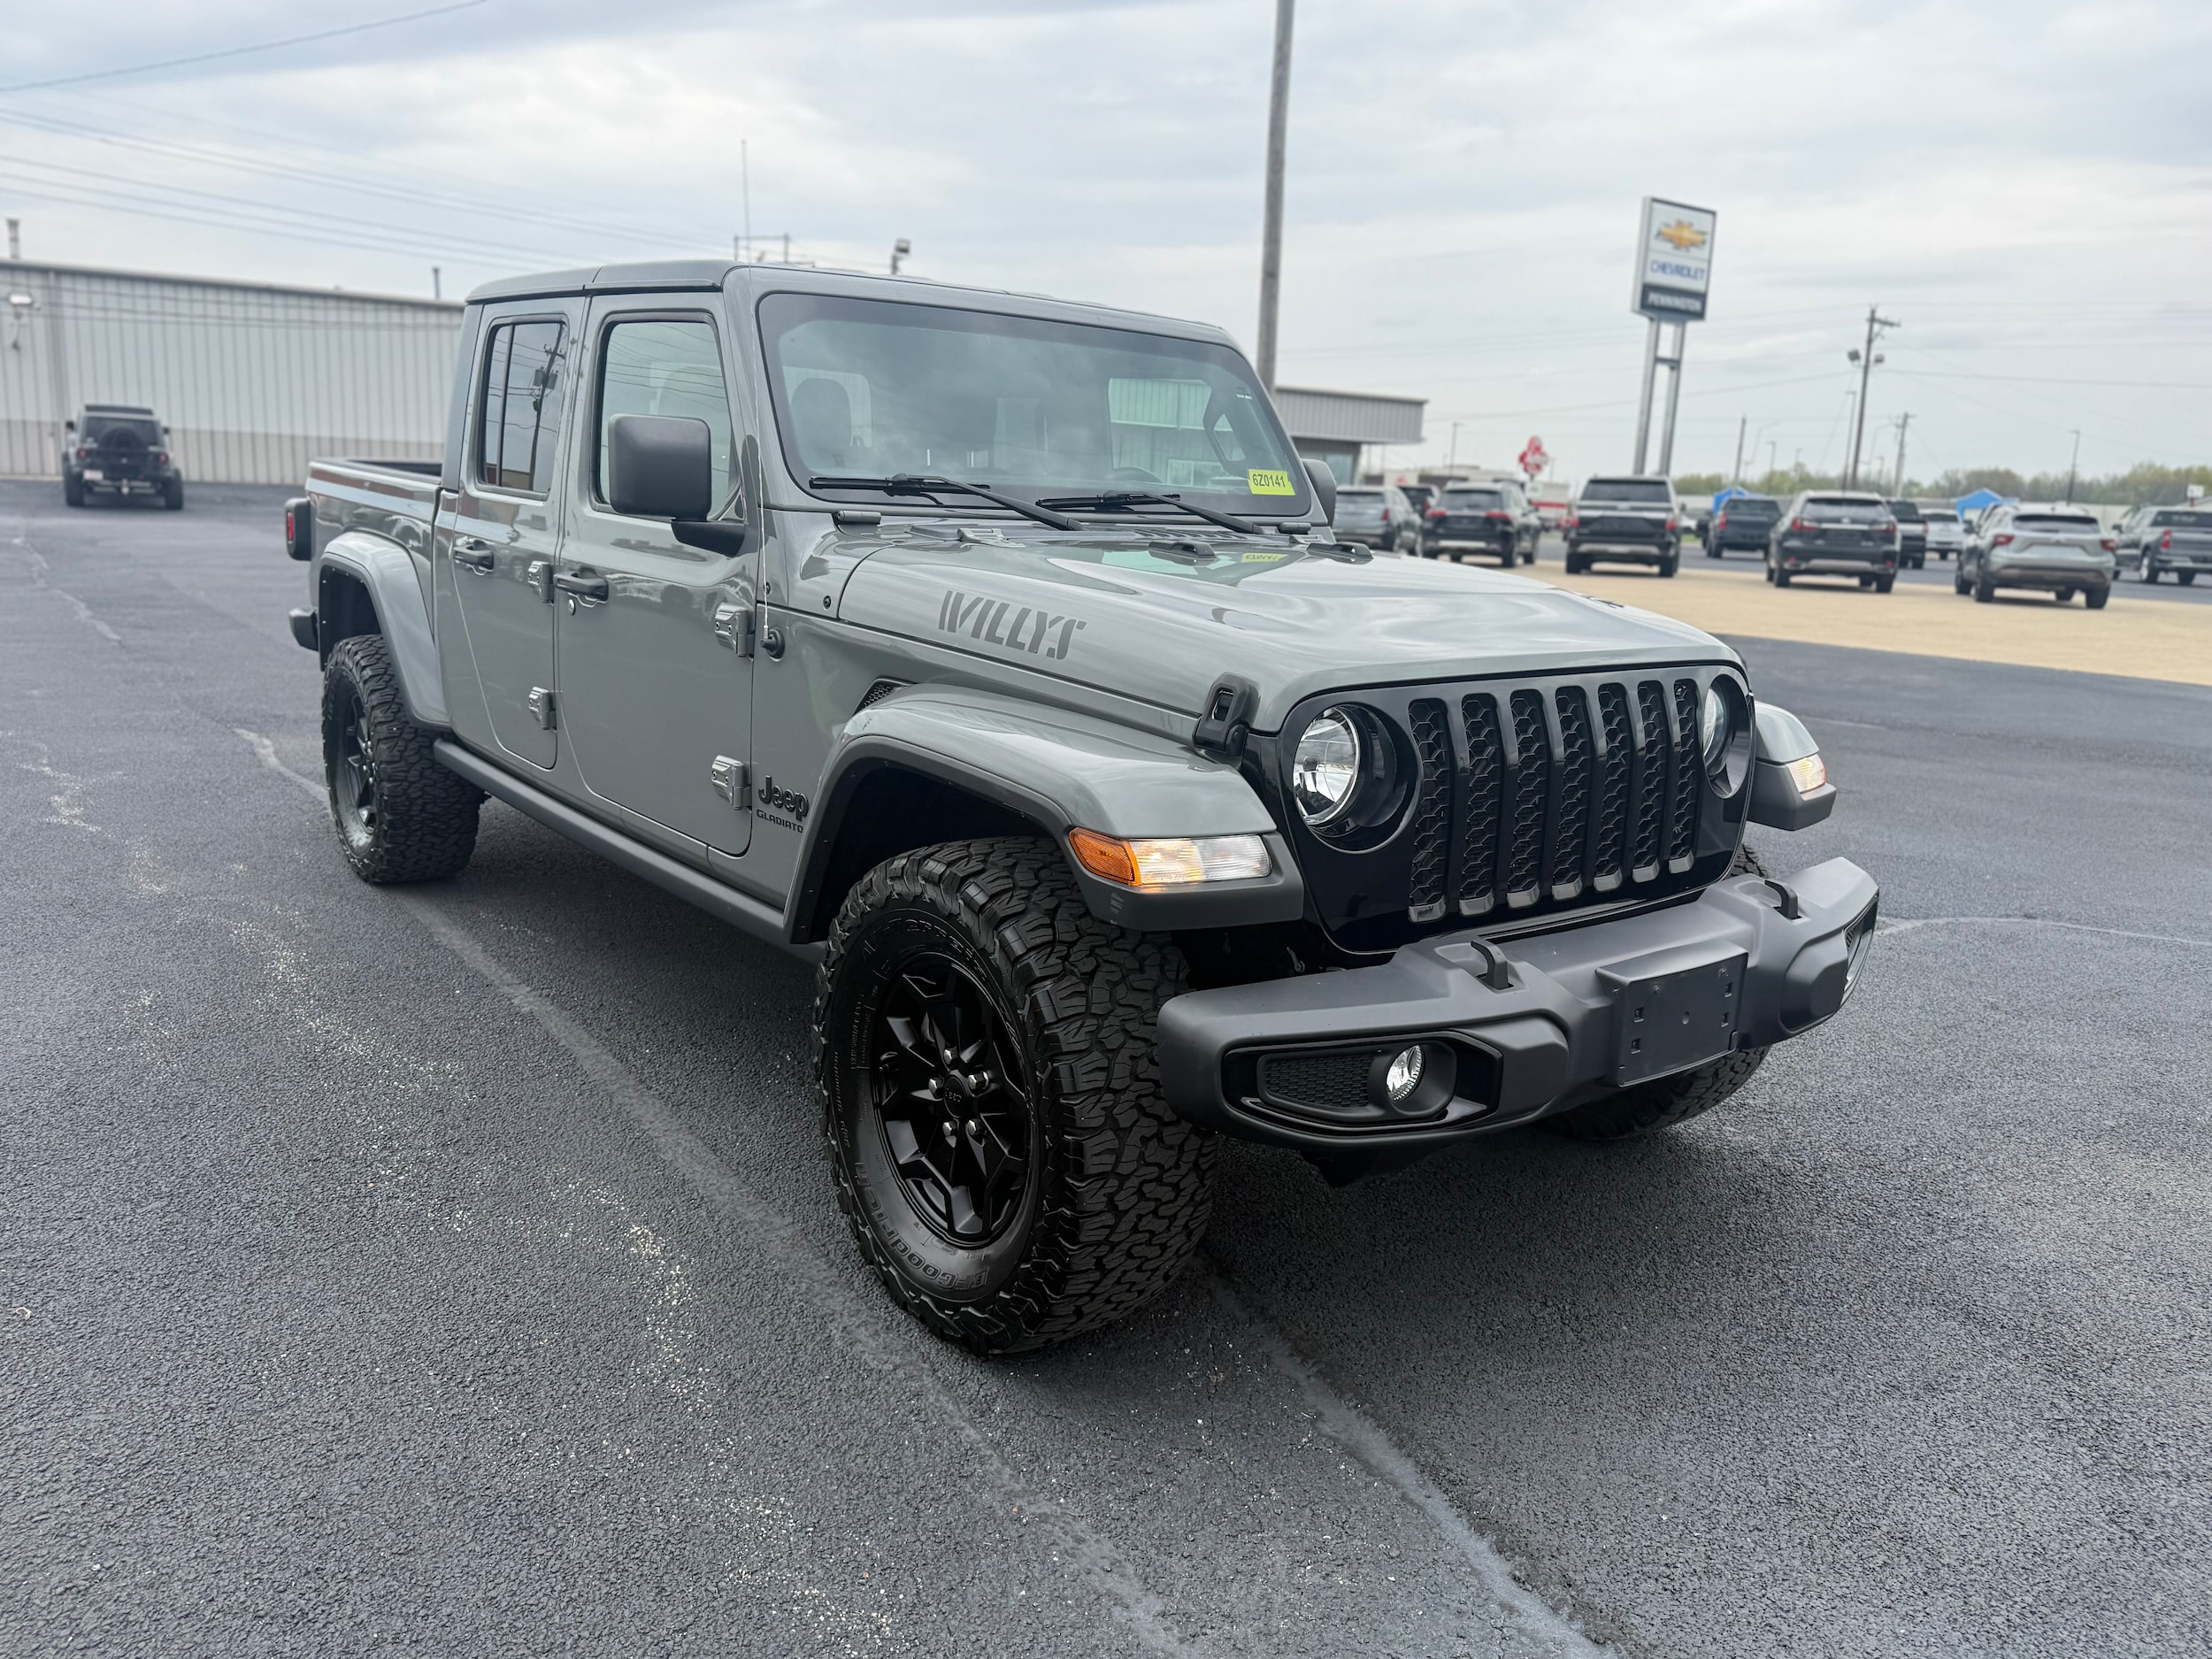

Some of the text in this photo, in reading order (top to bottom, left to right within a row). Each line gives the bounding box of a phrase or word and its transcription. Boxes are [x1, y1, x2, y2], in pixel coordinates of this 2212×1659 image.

[1649, 259, 1704, 281] CHEVROLET
[1252, 473, 1286, 488] 6Z0141
[938, 590, 1087, 660] WILLYS
[758, 774, 810, 822] Jeep
[756, 809, 803, 833] GLADIATO
